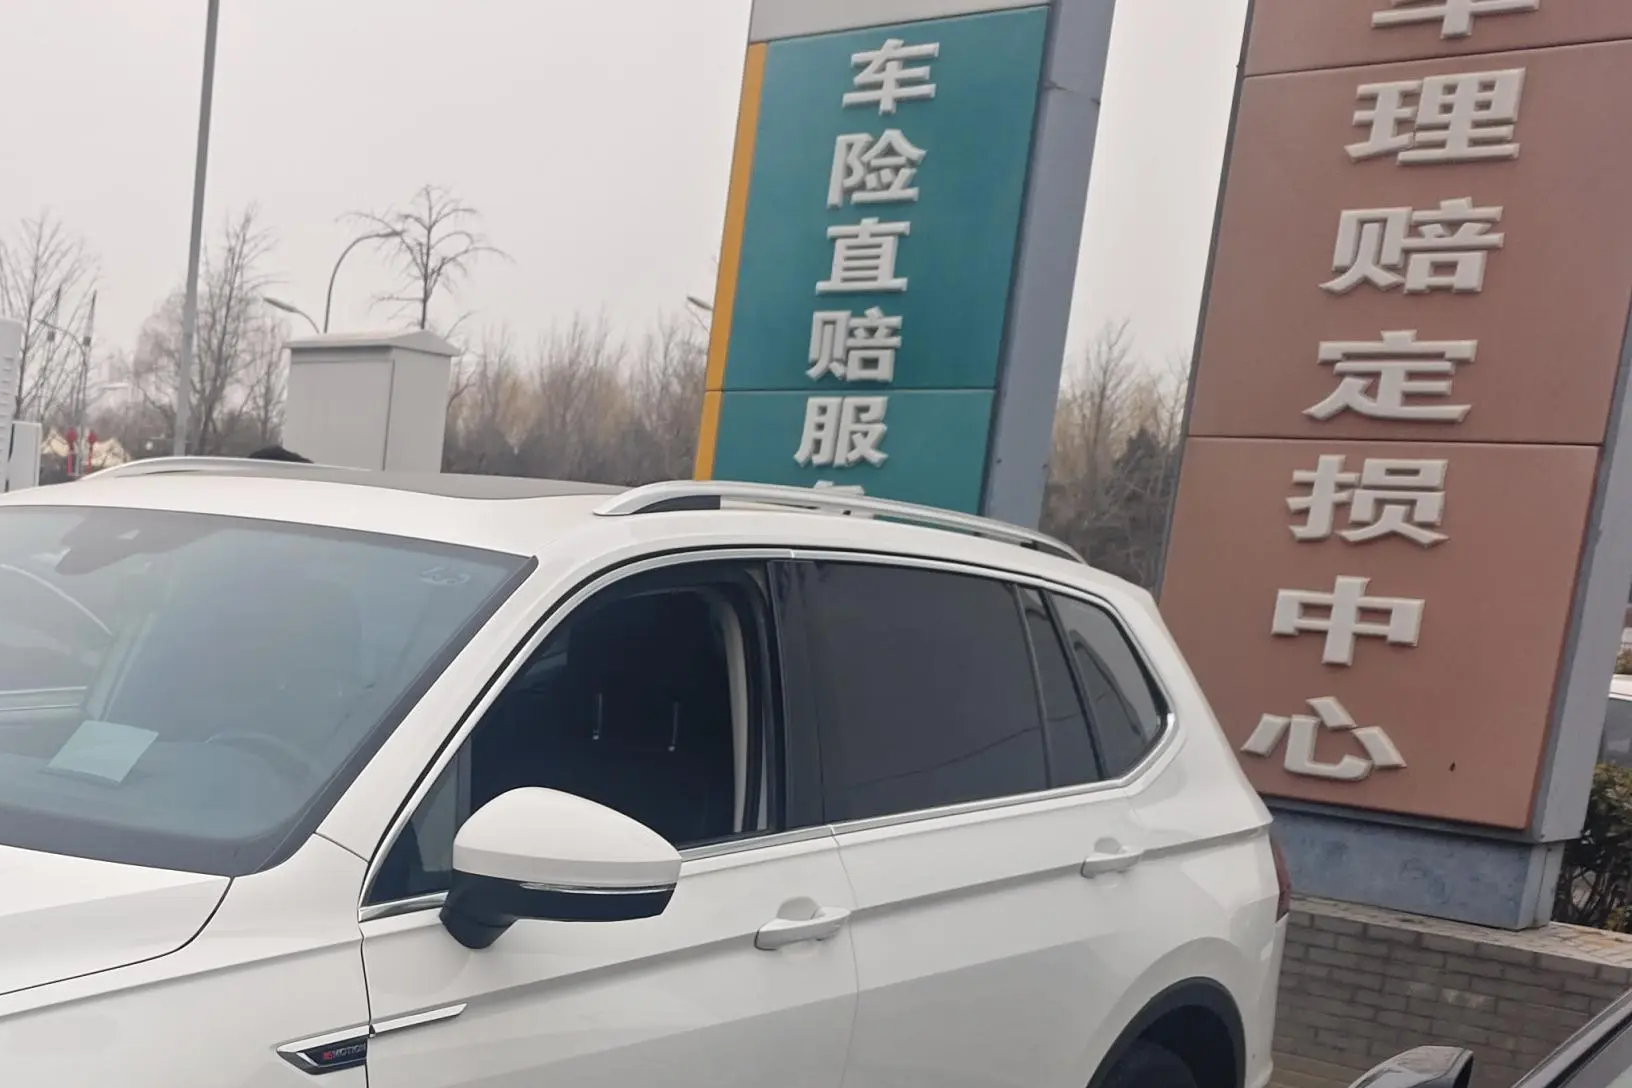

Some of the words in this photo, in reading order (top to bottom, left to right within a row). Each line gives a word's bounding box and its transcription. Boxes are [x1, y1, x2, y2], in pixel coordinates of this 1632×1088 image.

[795, 38, 940, 496] 车险直赔服
